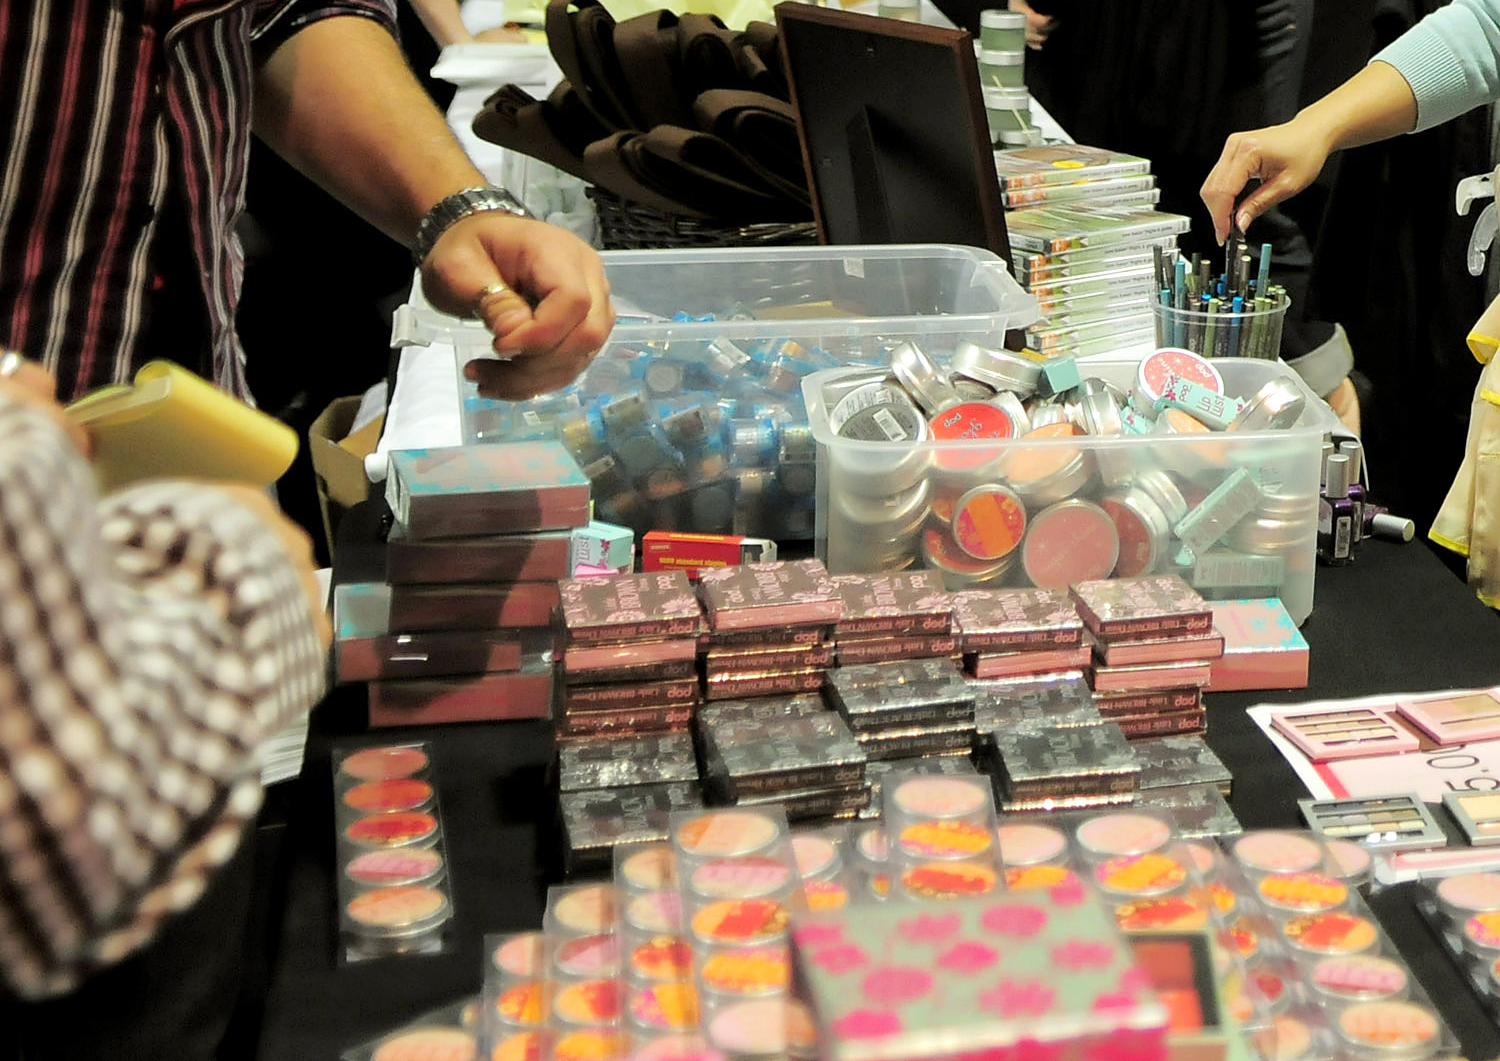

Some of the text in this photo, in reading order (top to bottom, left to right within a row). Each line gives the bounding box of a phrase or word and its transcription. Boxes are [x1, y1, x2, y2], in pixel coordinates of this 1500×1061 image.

[668, 620, 694, 635] pop
[923, 617, 946, 629] pop
[1186, 617, 1209, 631] pop
[804, 678, 822, 689] op
[667, 684, 692, 698] pop
[1174, 695, 1196, 707] pop
[1178, 716, 1200, 730] pop
